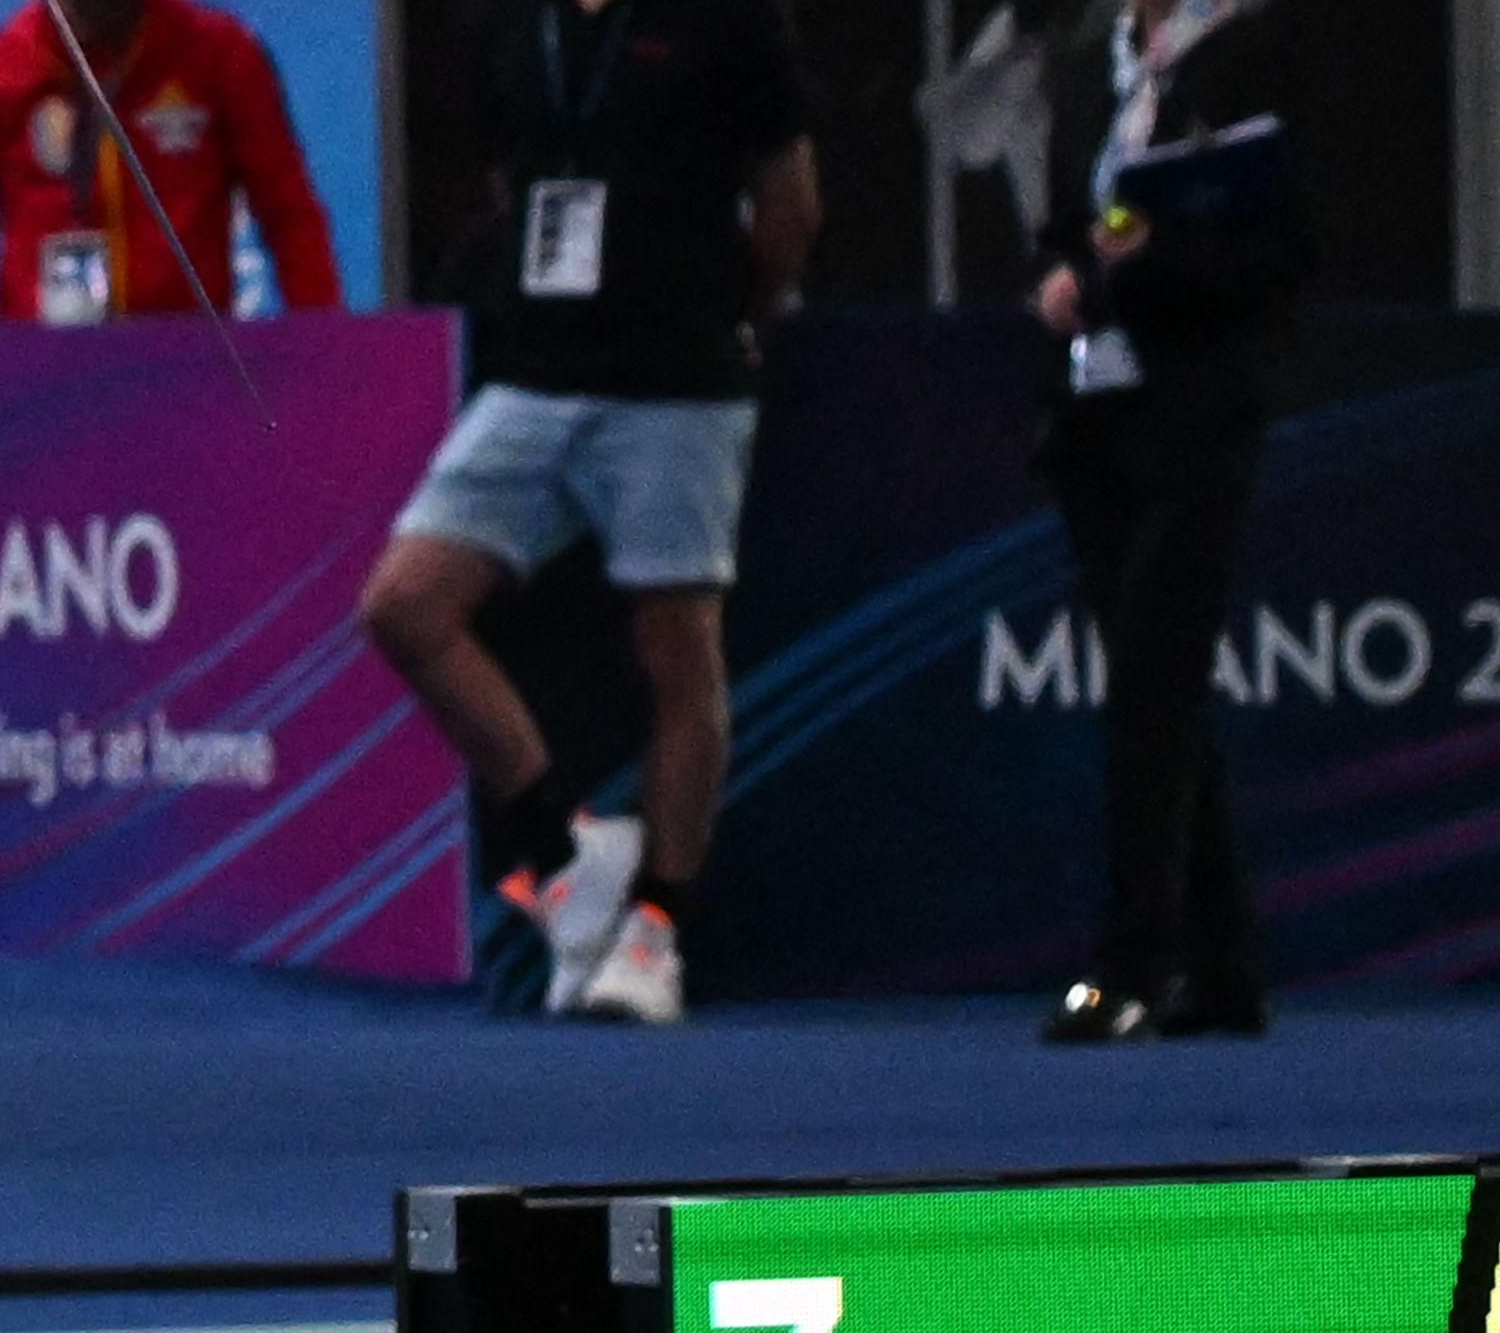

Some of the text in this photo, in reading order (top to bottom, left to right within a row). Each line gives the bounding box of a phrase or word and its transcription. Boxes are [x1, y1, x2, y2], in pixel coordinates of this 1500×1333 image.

[978, 599, 1432, 709] MINO
[60, 711, 98, 788] is
[103, 721, 147, 788] at
[149, 708, 275, 790] home
